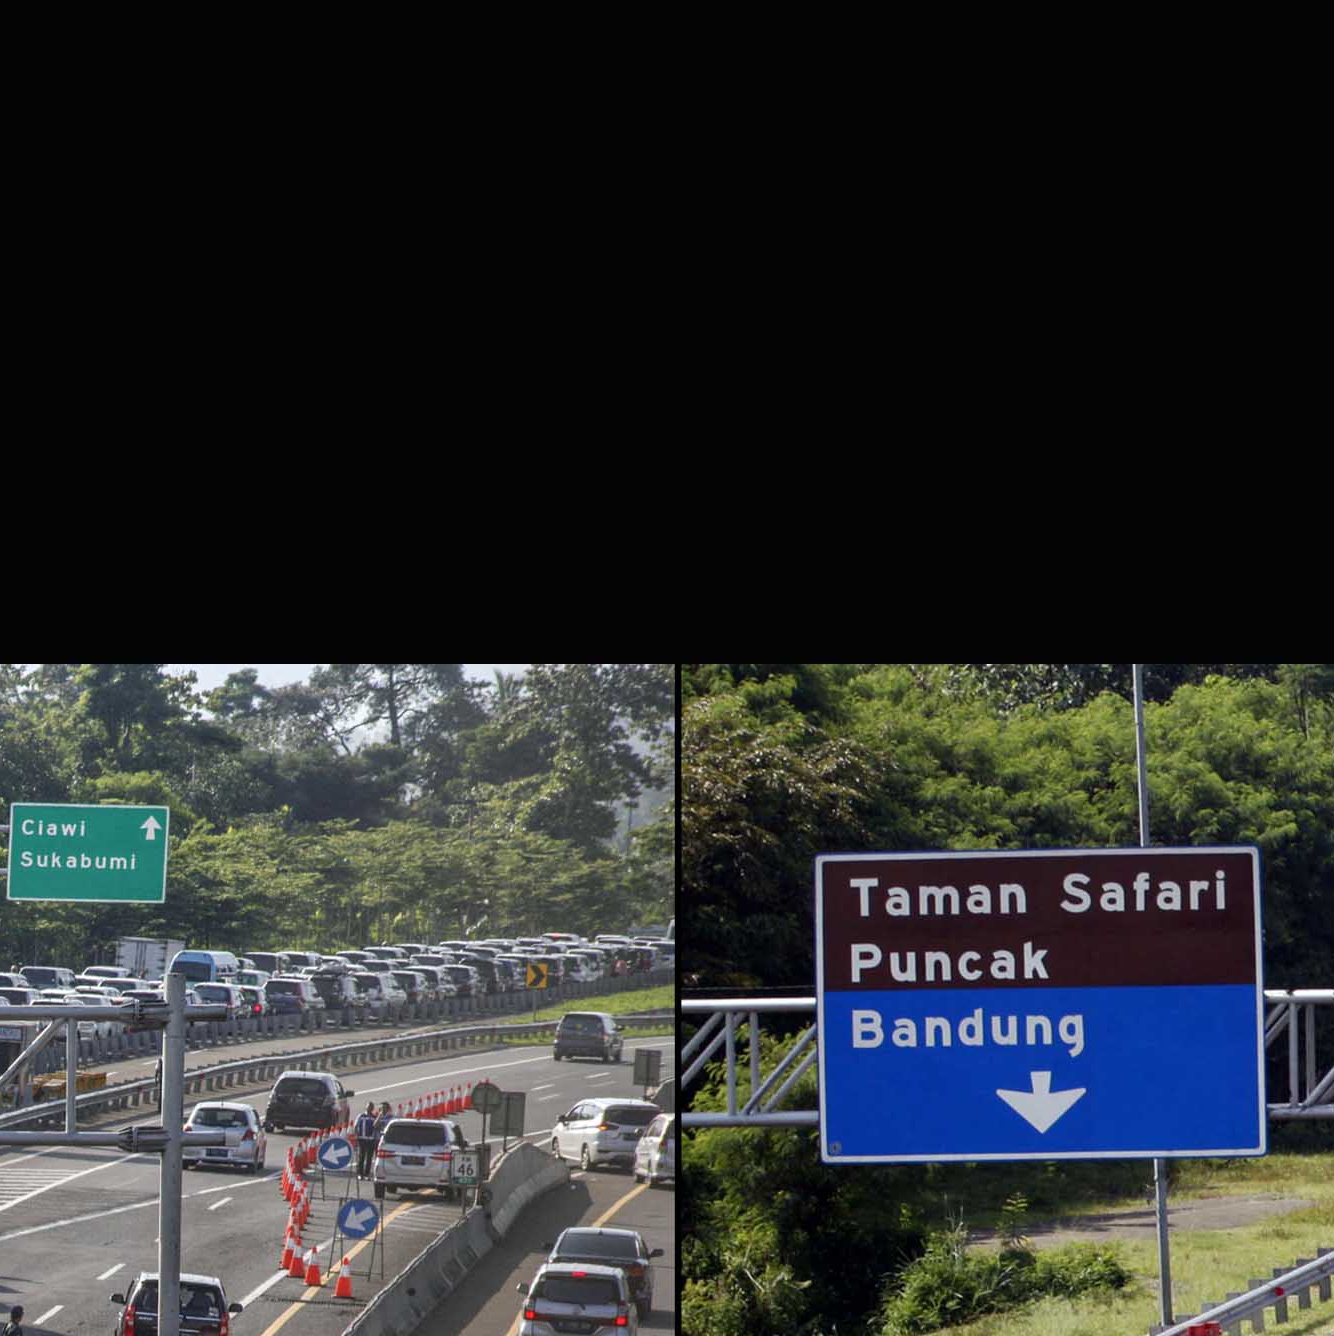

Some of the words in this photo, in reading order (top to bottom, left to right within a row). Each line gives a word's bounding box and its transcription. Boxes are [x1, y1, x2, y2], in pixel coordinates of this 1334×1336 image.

[21, 819, 85, 836] Ciawi
[20, 851, 136, 870] Sukabumi
[850, 878, 1026, 917] Taman
[1060, 870, 1226, 913] Safari
[851, 941, 1049, 983] Puncak
[852, 1008, 1085, 1057] Bandung
[458, 1163, 474, 1176] 46
